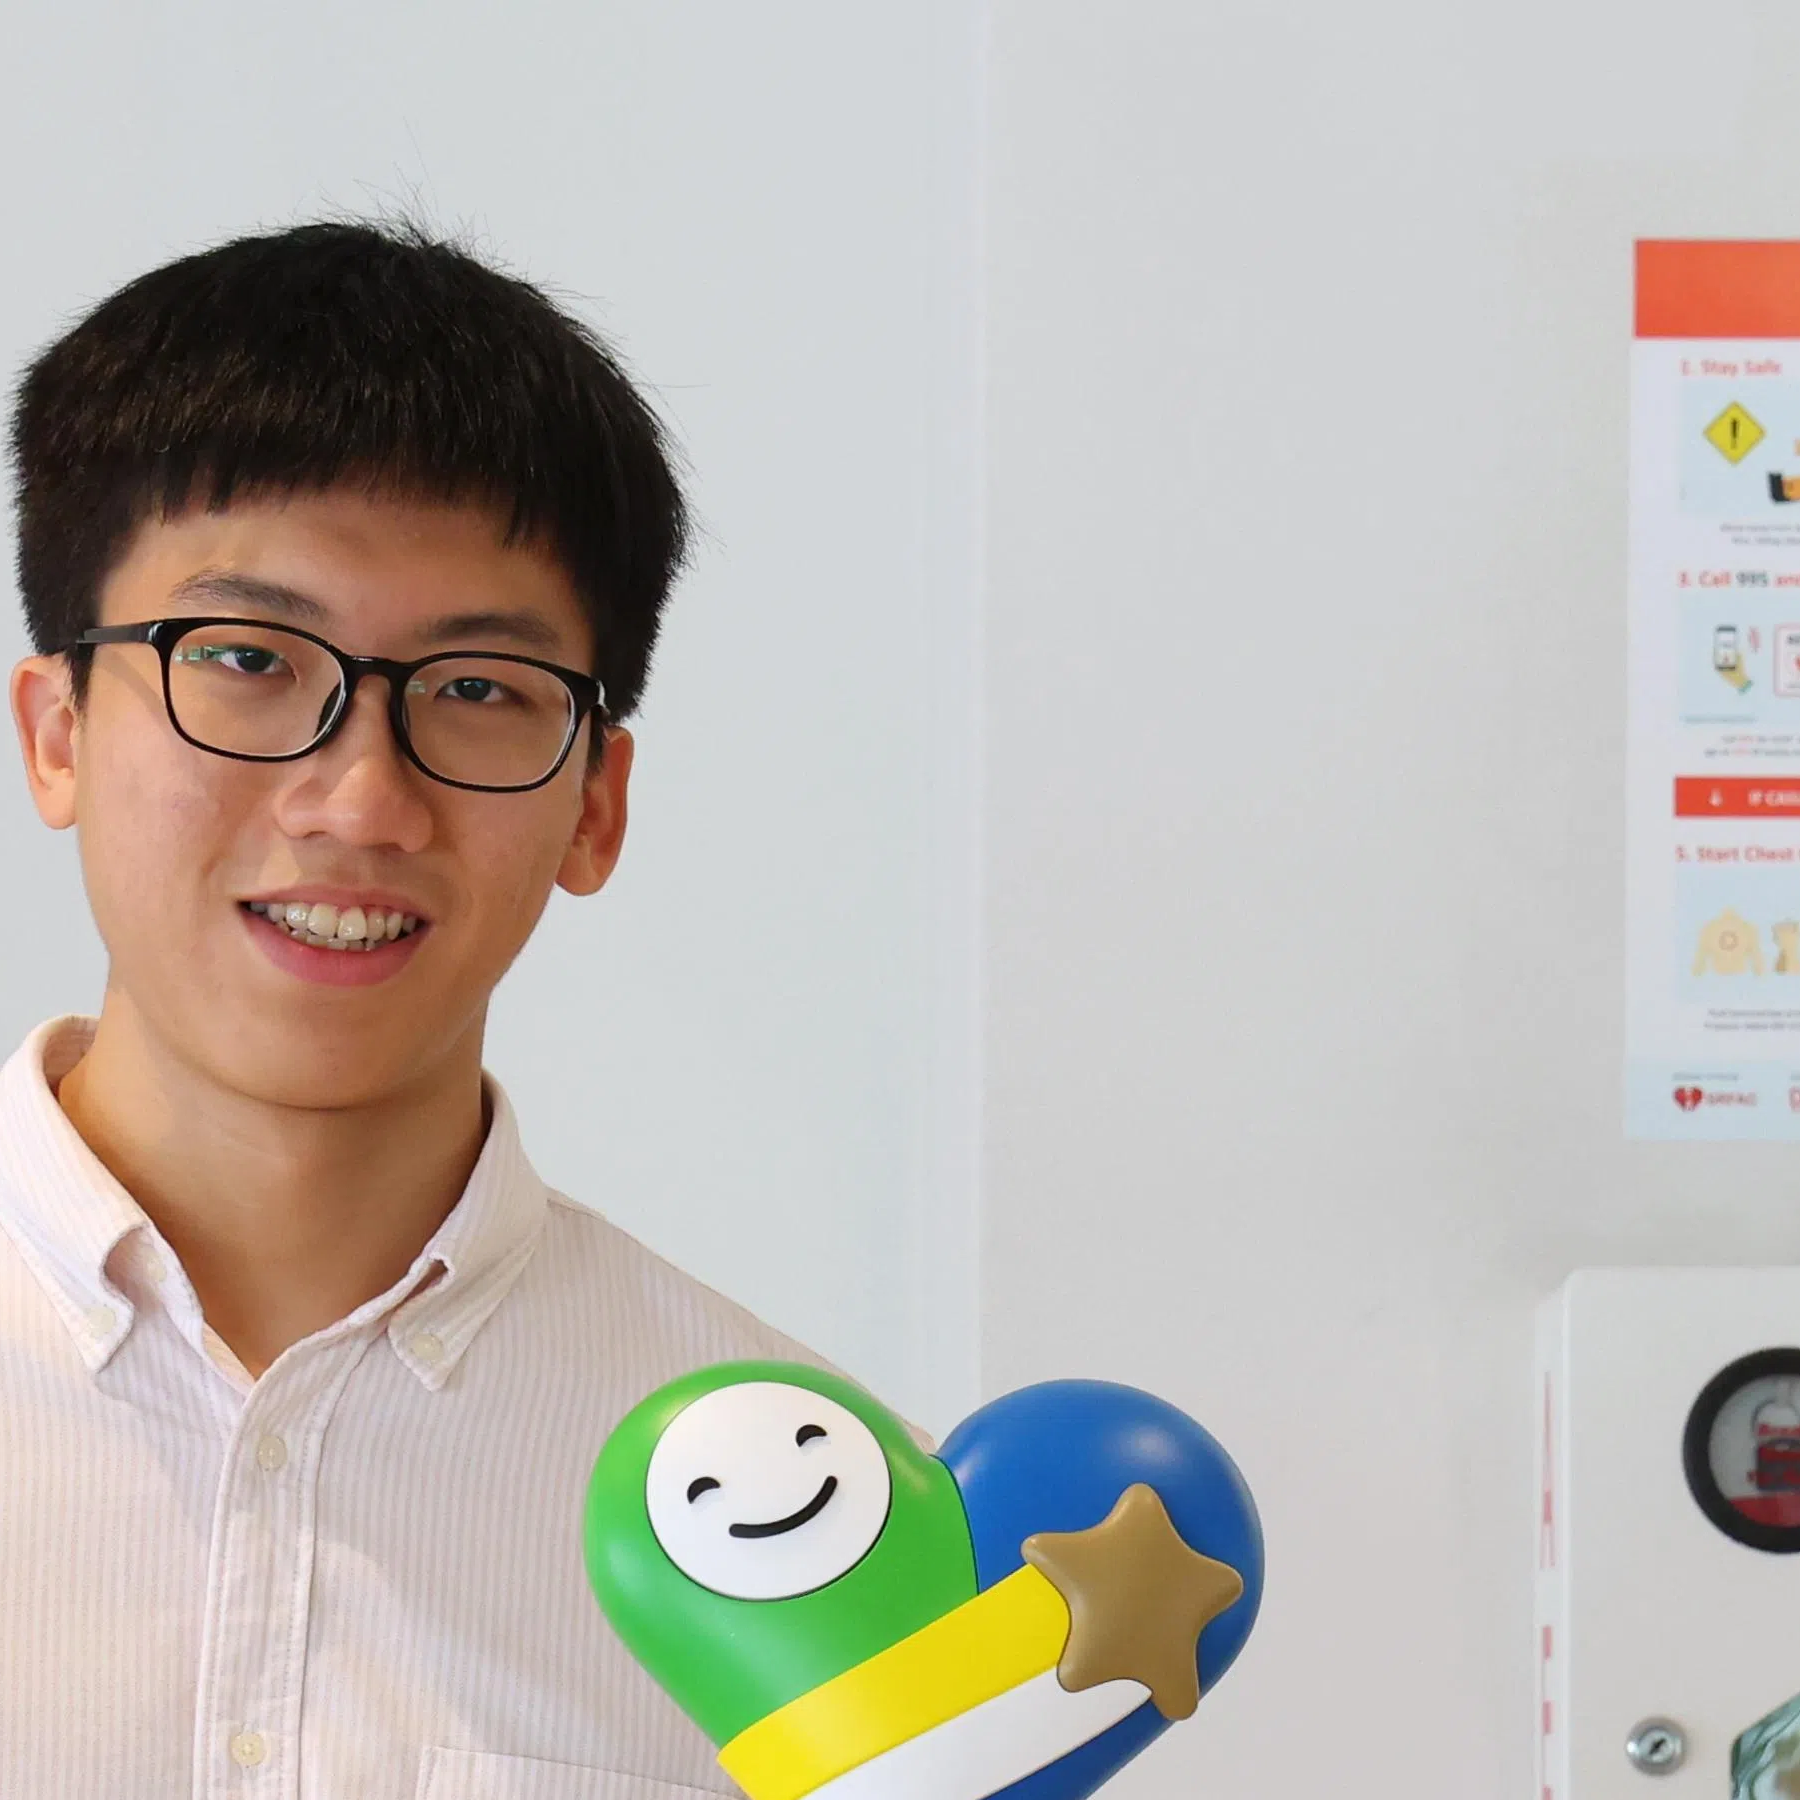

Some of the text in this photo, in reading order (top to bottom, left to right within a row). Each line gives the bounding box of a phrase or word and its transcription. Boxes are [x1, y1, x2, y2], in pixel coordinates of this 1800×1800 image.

[1701, 360, 1738, 377] Stay
[1744, 360, 1781, 375] Safe
[1698, 571, 1731, 587] Call
[1736, 572, 1769, 587] 995
[1697, 845, 1739, 861] Start
[1745, 845, 1793, 861] Chest
